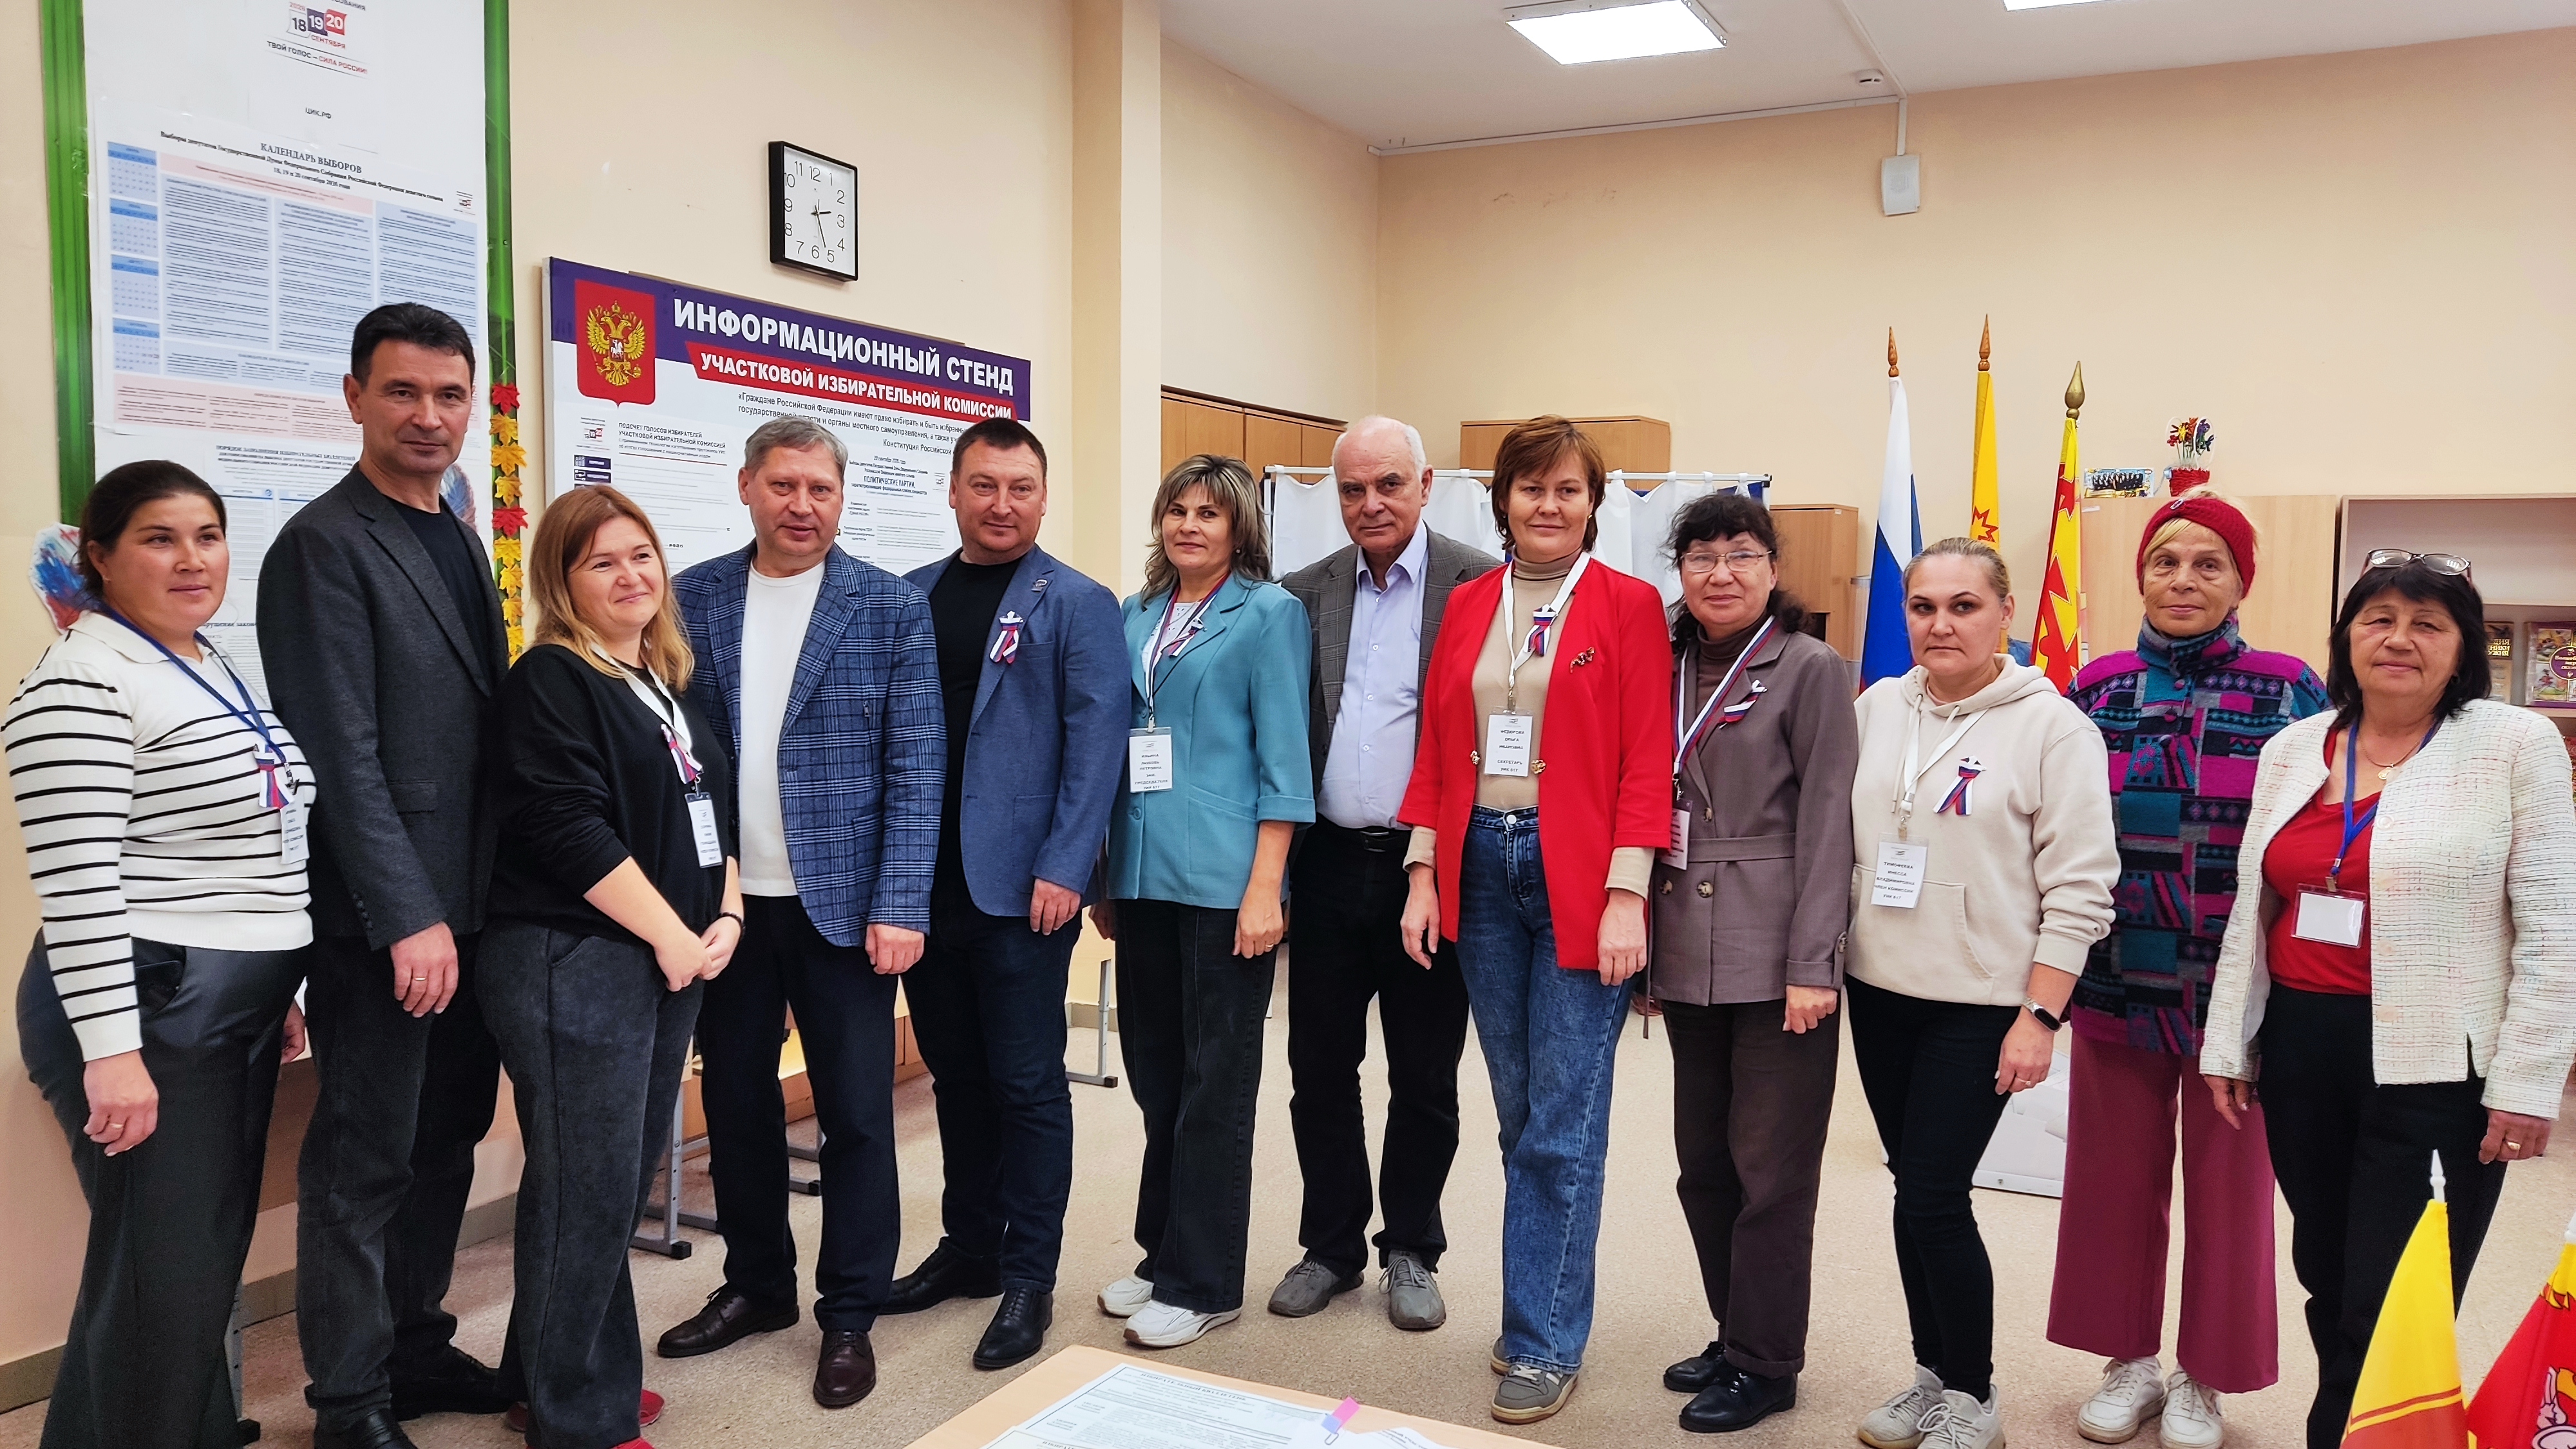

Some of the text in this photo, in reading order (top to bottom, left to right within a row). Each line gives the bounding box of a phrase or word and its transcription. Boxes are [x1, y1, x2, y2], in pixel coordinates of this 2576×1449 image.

[292, 14, 344, 32] 18 19 20
[311, 34, 346, 49] СЕНТЯБРЯ
[267, 41, 287, 52] ТВОЙ
[289, 46, 311, 59] ГОЛОС
[319, 55, 337, 66] СИЛА
[261, 142, 362, 174] КАЛЕНДАРЬ ВЫБОРОВ
[795, 161, 802, 176] 11
[810, 166, 821, 182] 12
[784, 173, 795, 188] 10
[837, 189, 845, 204] 2
[784, 198, 793, 212] 9
[837, 214, 845, 228] 3
[784, 223, 793, 236] 8
[796, 240, 804, 254] 7
[811, 245, 820, 259] 6
[837, 238, 845, 251] 4
[827, 250, 835, 263] 5
[674, 298, 1014, 396] ИНФОРМАЦИОННЫЙ СТЕНД
[701, 352, 1012, 419] УЧАСТКОВОЙ ИЗБИРАТЕЛЬНОЙ КОМИССИИ
[777, 397, 815, 412] Российской
[817, 404, 852, 417] Федерации
[853, 411, 873, 420] имеют
[874, 414, 891, 423] право
[893, 417, 919, 427] избирать
[925, 420, 939, 430] быть
[618, 422, 703, 438] ПОДСЧЕТ ГОЛОСОВ ИЗБИРАТЕЛЕЙ
[828, 419, 850, 428] органы
[852, 422, 879, 431] местного
[881, 426, 929, 440] самоуправления,
[618, 430, 726, 449] УЧАСТКОВОЙ ИЗБИРАТЕЛЬНОЙ КОМИССИЕЙ
[883, 439, 951, 455] Конституция Российской
[864, 475, 898, 486] ПОЛИТИЧЕСКИЕ
